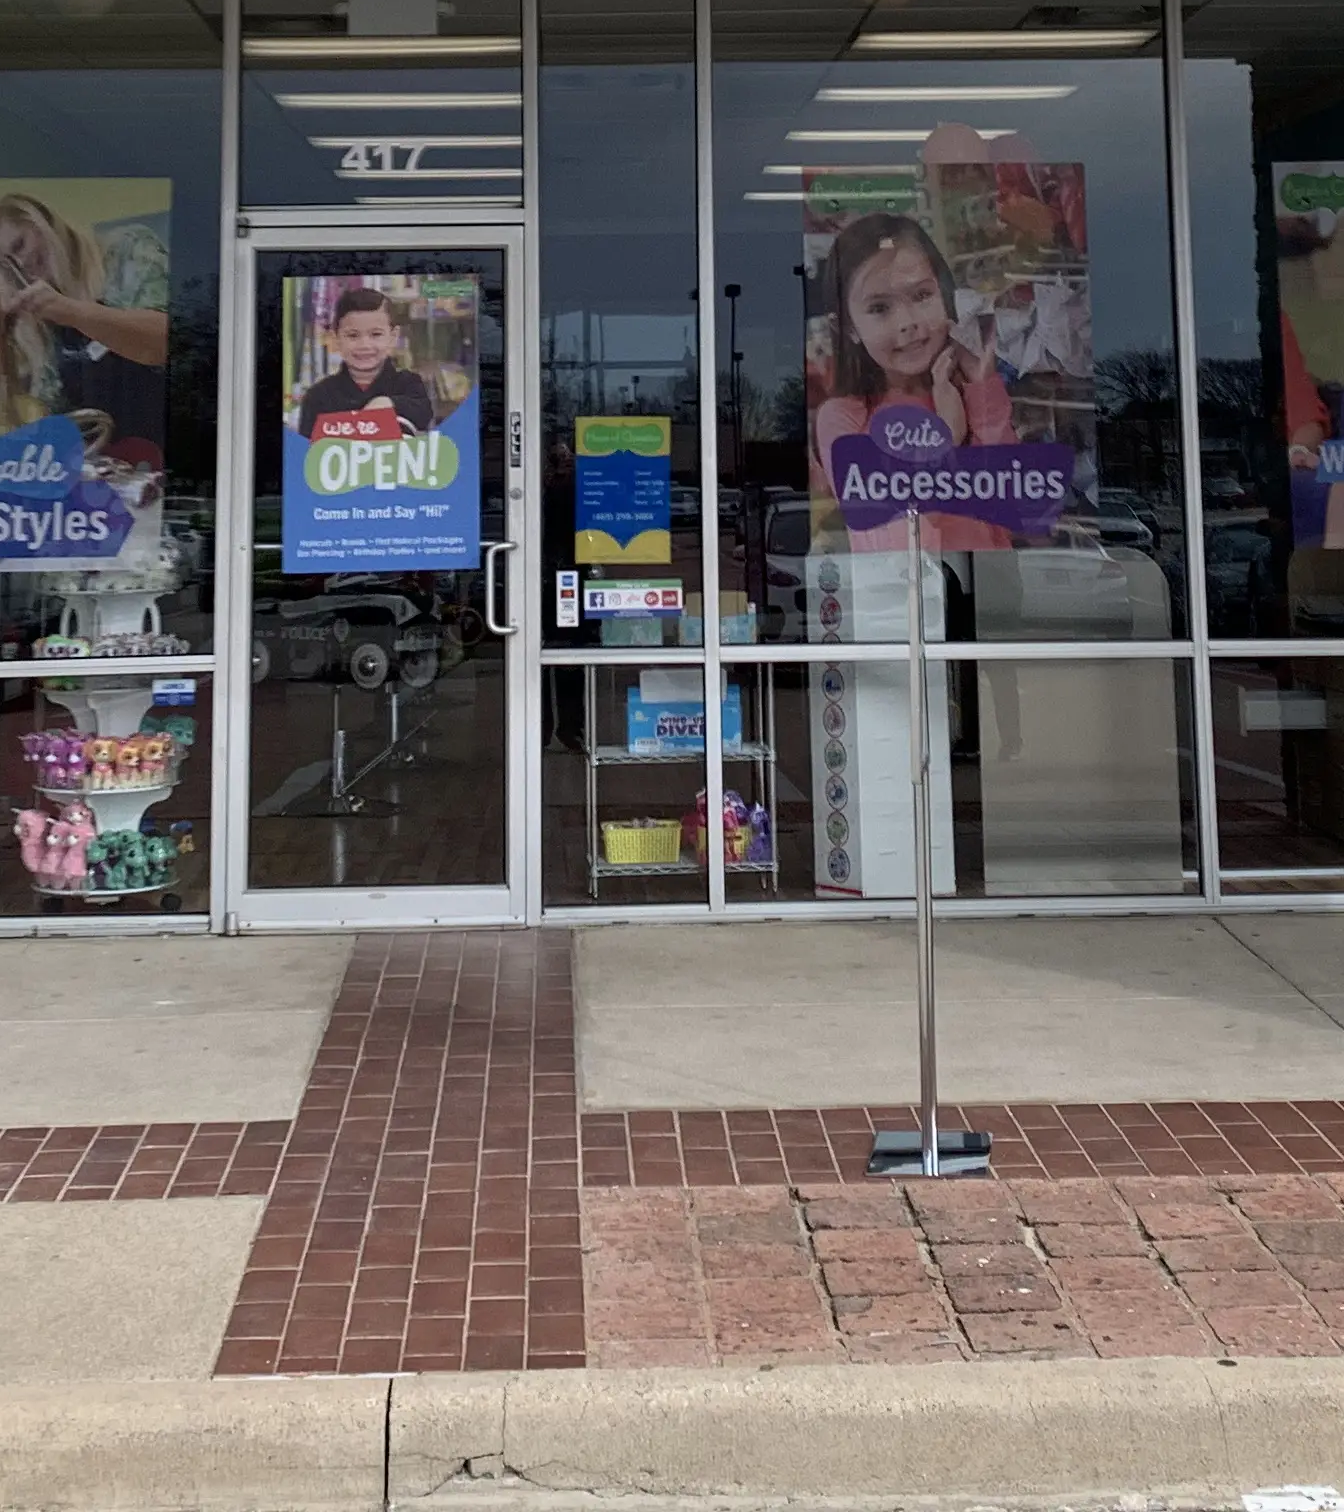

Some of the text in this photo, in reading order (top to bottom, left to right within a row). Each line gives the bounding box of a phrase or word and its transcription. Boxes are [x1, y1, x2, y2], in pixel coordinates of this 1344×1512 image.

[340, 143, 428, 172] 417
[884, 418, 945, 451] Cute
[318, 430, 441, 492] OPEN!
[842, 459, 1066, 501] Accessories
[313, 506, 349, 520] Come
[367, 505, 392, 519] and
[394, 505, 416, 520] Say
